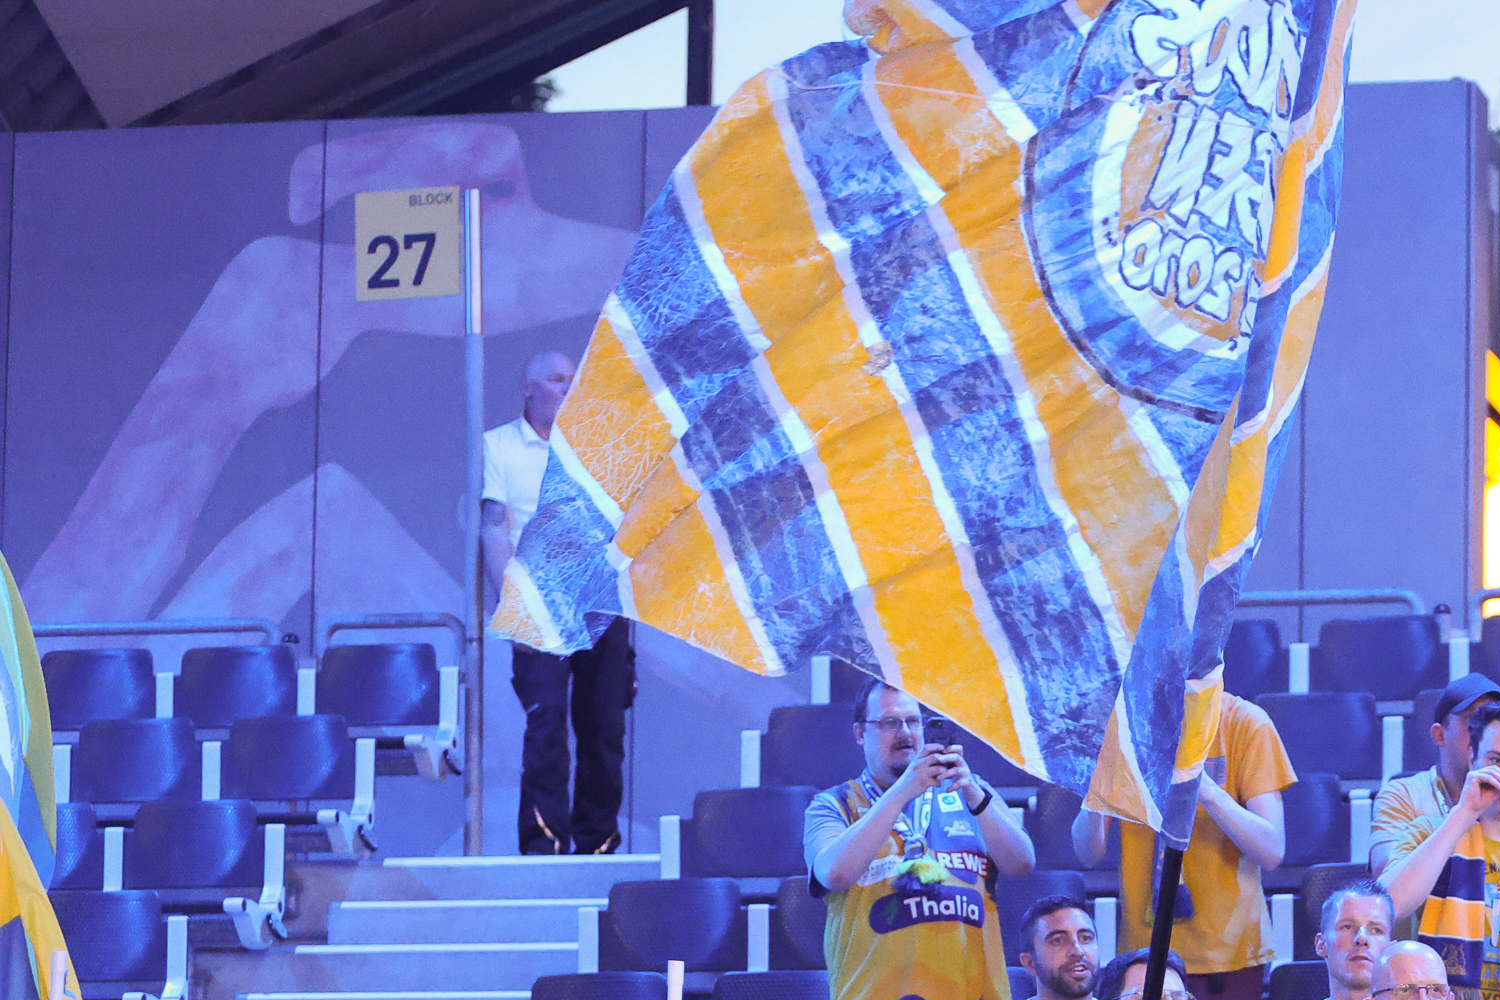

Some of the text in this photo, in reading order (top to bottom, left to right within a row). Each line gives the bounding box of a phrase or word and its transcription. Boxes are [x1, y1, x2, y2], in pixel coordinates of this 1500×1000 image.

[408, 191, 453, 208] BLOCK
[367, 232, 437, 290] 27
[936, 852, 988, 877] REWE
[903, 894, 980, 921] Thalia
